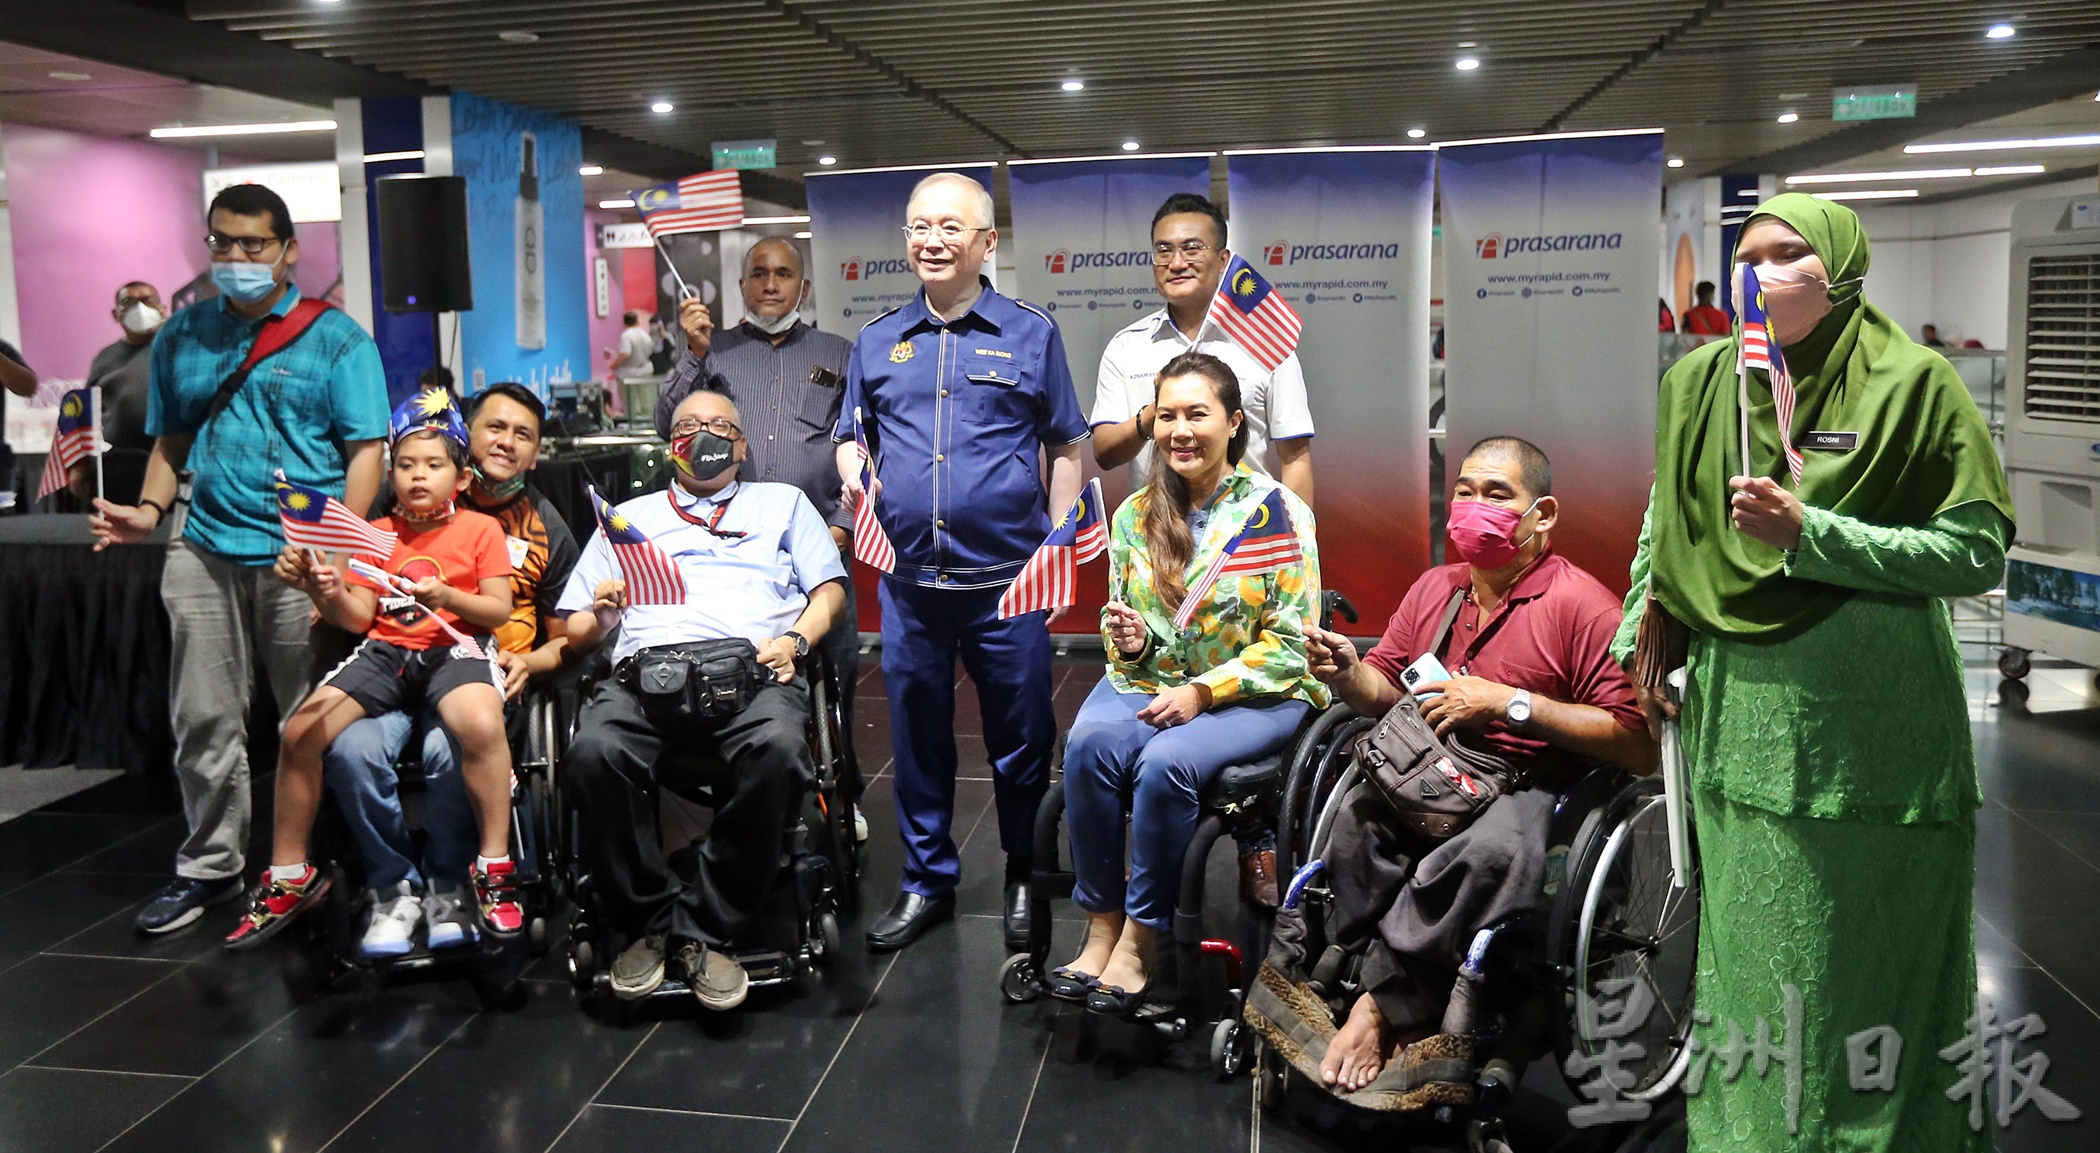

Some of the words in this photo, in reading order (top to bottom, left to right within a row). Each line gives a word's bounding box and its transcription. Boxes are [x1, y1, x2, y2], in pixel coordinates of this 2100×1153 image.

[1503, 233, 1622, 259] prasarana
[1289, 243, 1398, 265] prasarana
[1070, 251, 1153, 273] prasara
[1487, 271, 1610, 283] www.myrapid.com.my
[1275, 280, 1388, 290] www.myrapid.com.my
[852, 292, 915, 303] www.myrapid
[1057, 286, 1158, 298] www.myrapid.com.m
[1816, 436, 1840, 445] ROSNI
